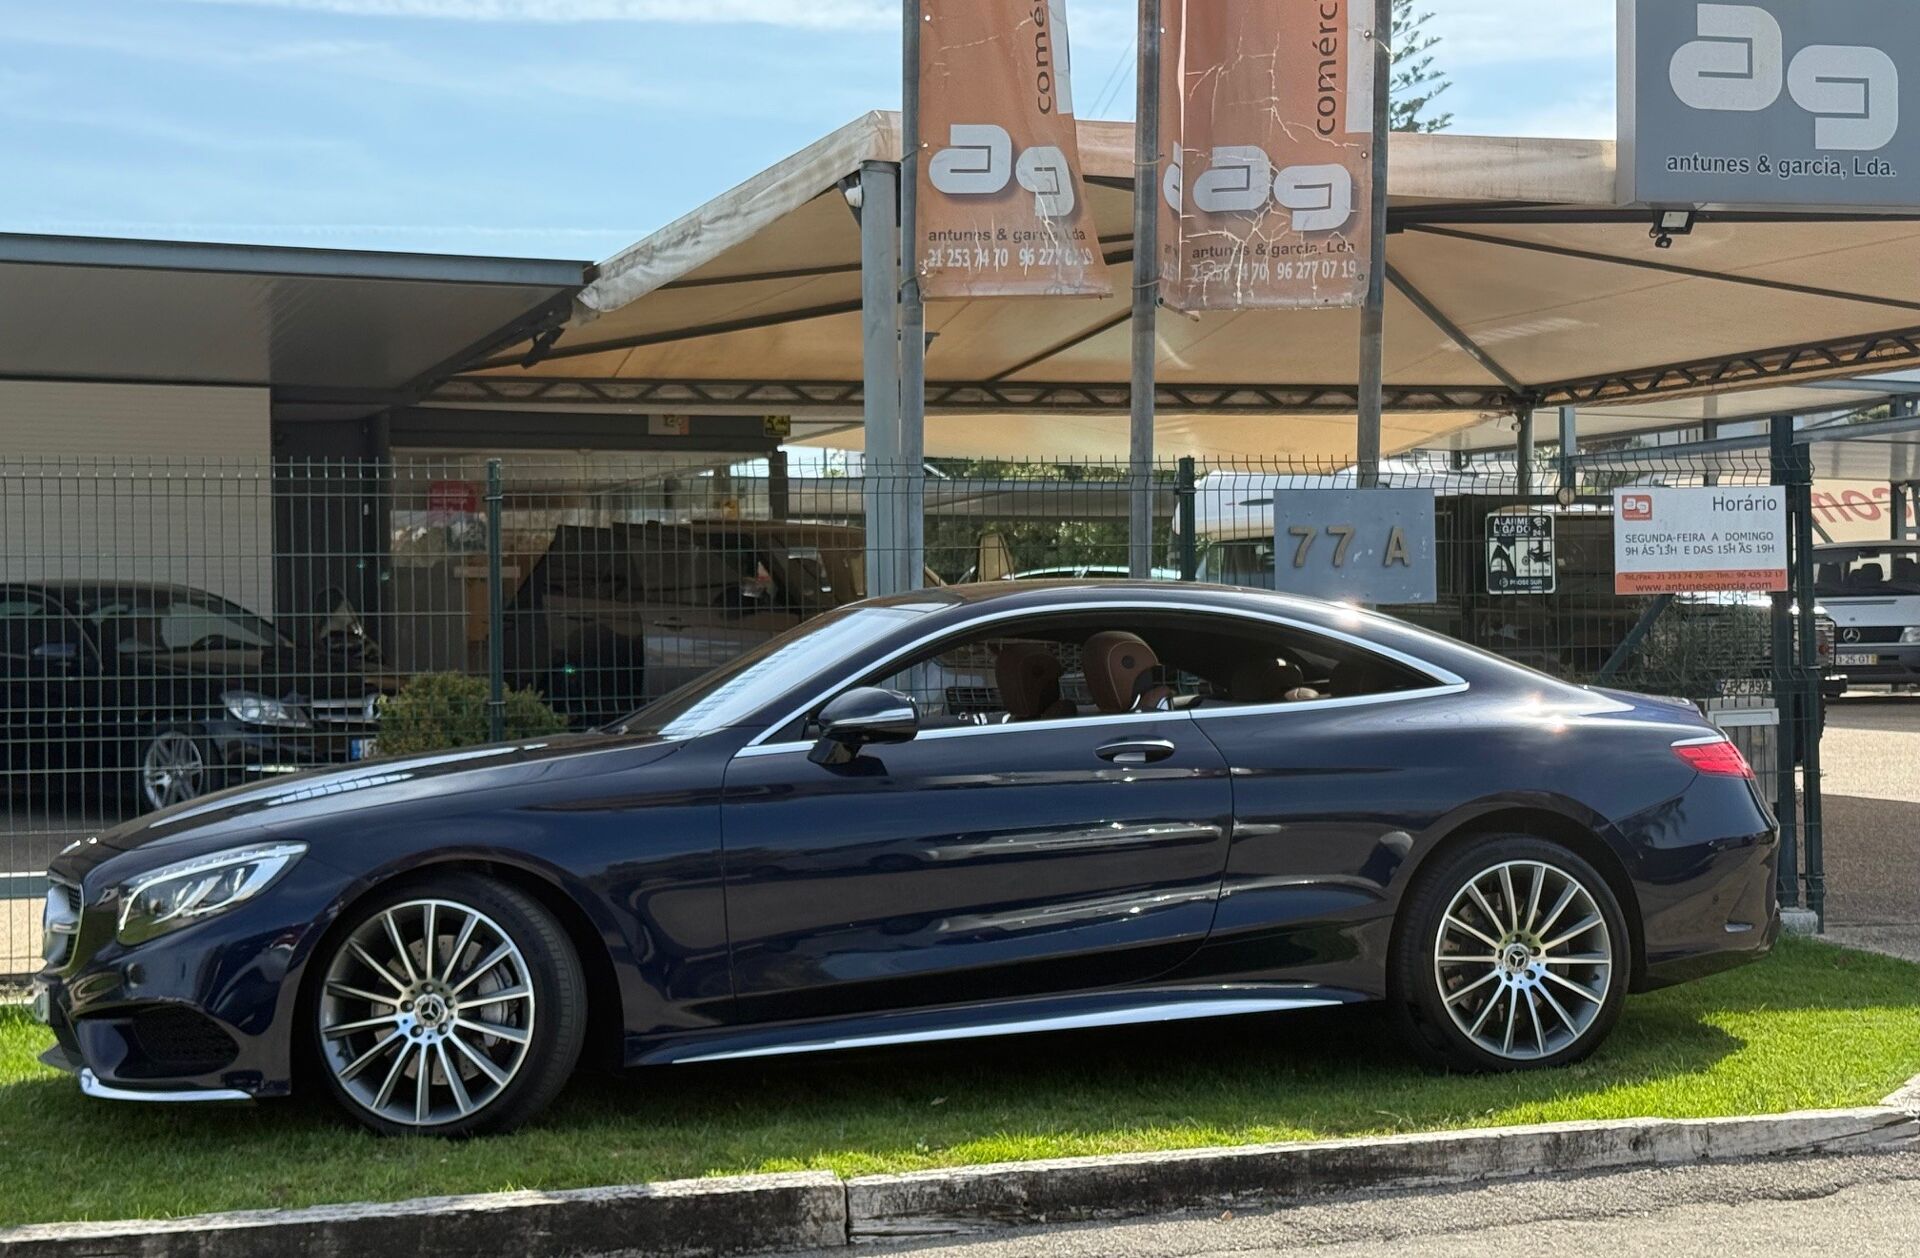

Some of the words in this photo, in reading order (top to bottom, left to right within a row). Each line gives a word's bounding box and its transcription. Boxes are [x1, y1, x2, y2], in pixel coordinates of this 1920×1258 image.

[1030, 0, 1051, 115] comé
[1312, 0, 1338, 135] comérc
[1666, 153, 1750, 174] antunes
[1756, 154, 1772, 173] &
[1778, 156, 1847, 179] garcia,
[1854, 158, 1896, 177] Lda.
[996, 228, 1009, 241] &
[947, 248, 970, 267] 253
[1256, 243, 1267, 255] &
[1277, 262, 1293, 280] 96
[1322, 259, 1337, 279] 07
[1342, 259, 1356, 278] 19
[1713, 494, 1777, 512] Horário
[1625, 533, 1705, 544] SEGUNDA-FEIRA
[1712, 532, 1719, 541] A
[1725, 531, 1774, 541] DOMINGO
[1625, 547, 1638, 556] 9H
[1659, 546, 1677, 555] 13H
[1684, 546, 1690, 555] E
[1693, 546, 1713, 554] DAS
[1718, 545, 1736, 554] 15H
[1756, 544, 1775, 554] 19H
[1636, 580, 1772, 592] www.antunesegarcia.com
